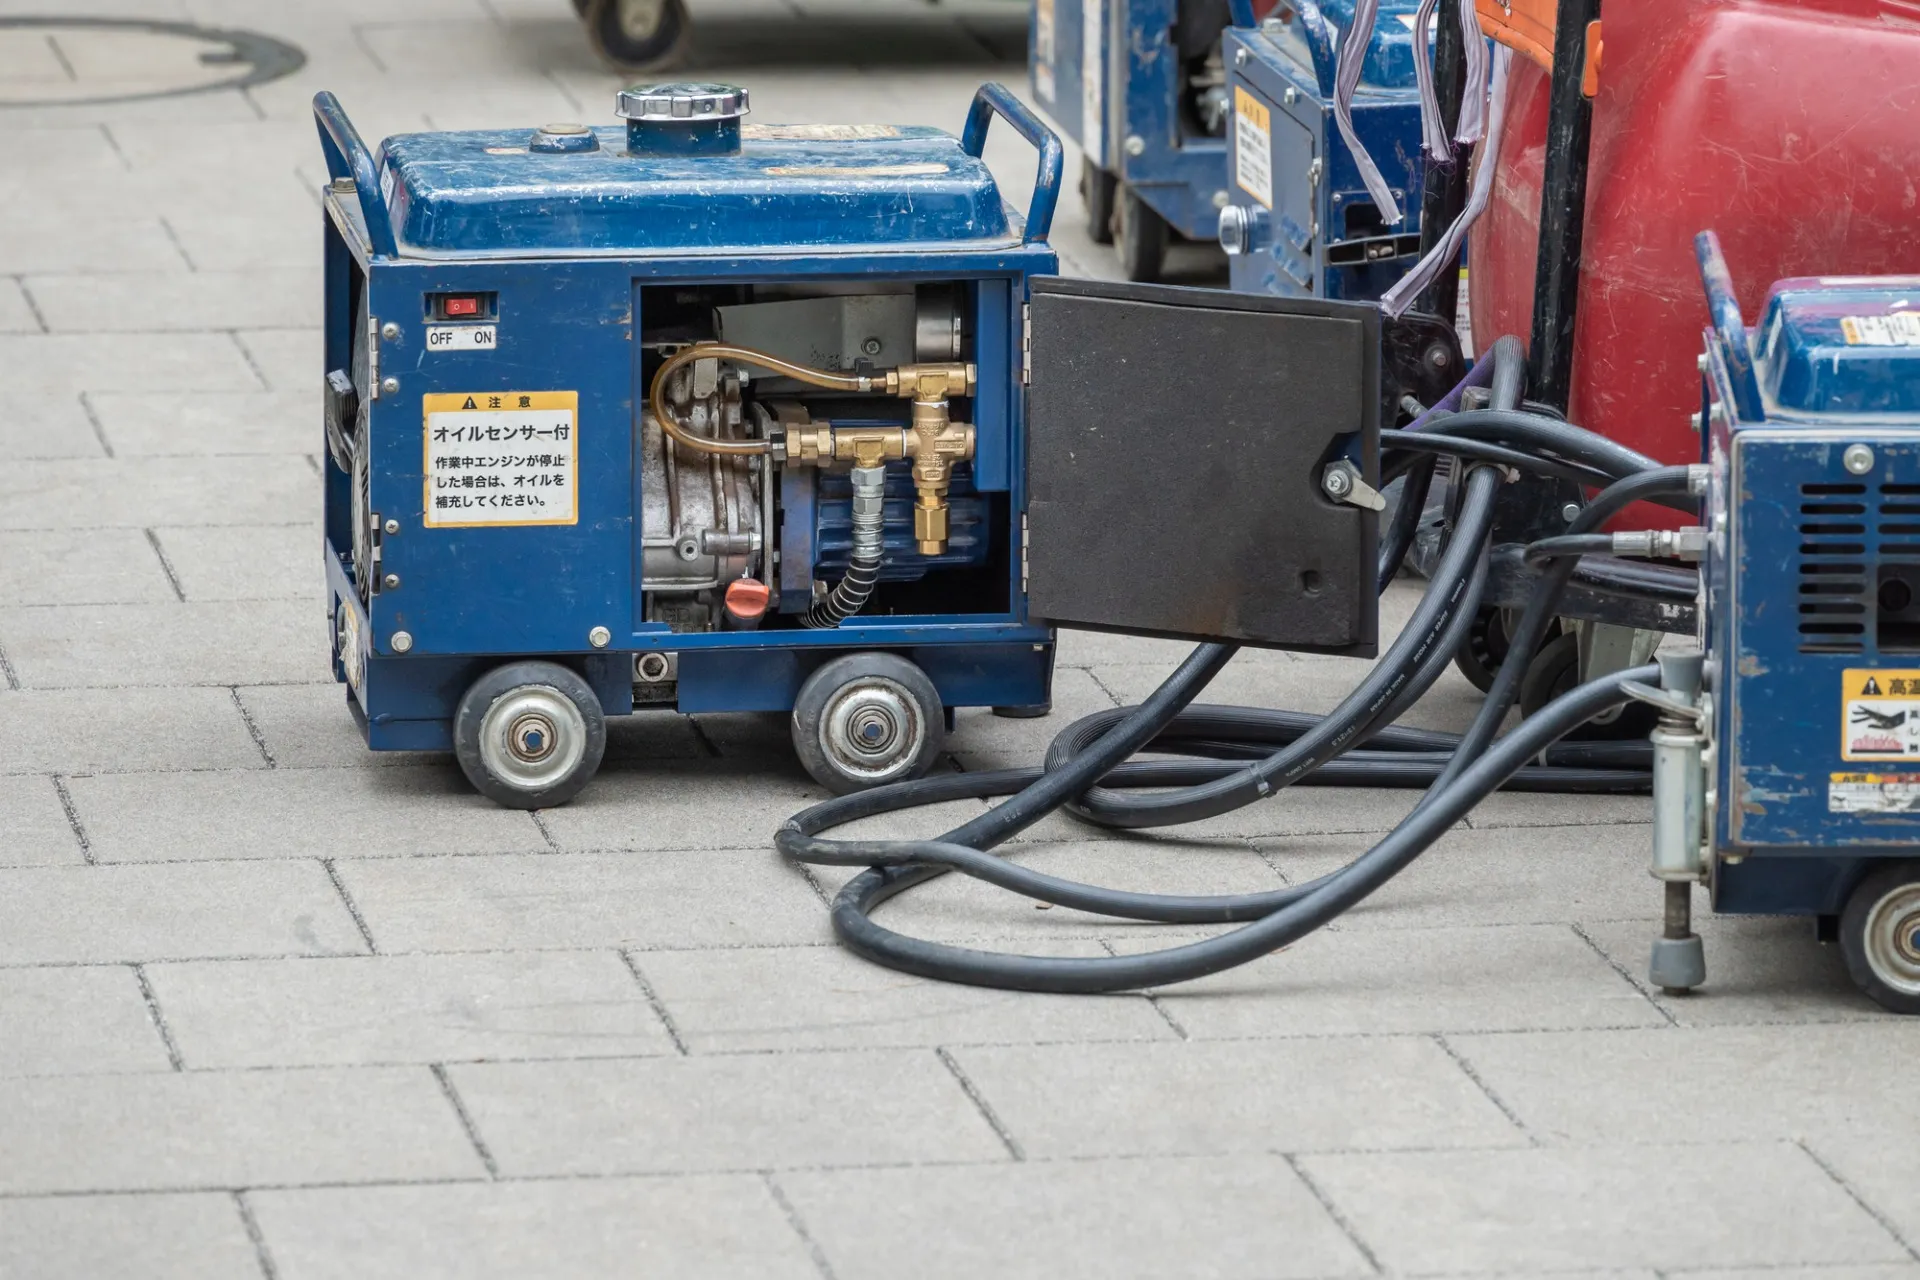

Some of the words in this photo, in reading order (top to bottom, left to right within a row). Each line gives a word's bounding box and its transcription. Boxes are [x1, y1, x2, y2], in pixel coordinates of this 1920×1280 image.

[430, 332, 453, 345] OFF
[474, 331, 492, 343] ON
[433, 424, 570, 442] オイルセンサー付
[435, 454, 565, 469] 作業中エンジンが停止
[437, 474, 565, 488] した場合は、オイルを
[435, 495, 546, 509] 補充してください。
